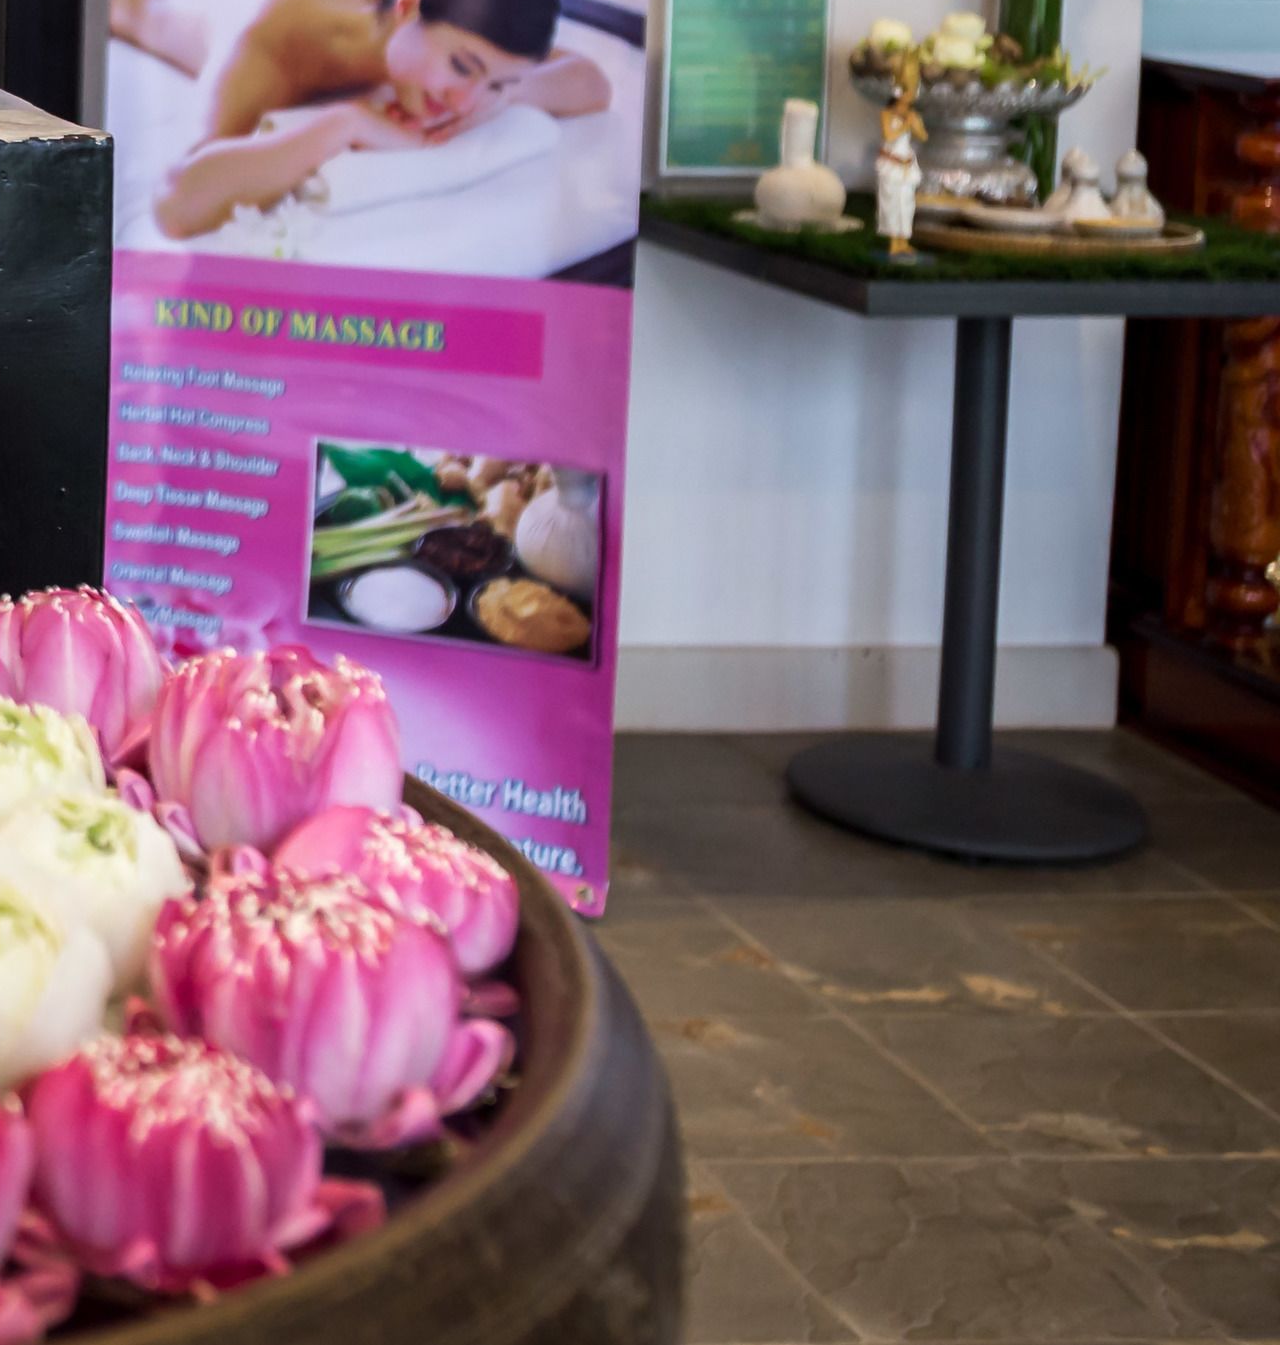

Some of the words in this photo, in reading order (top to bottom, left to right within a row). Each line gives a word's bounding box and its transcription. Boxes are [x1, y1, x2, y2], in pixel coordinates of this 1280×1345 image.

[155, 299, 235, 333] KIND
[241, 304, 283, 338] OF
[289, 311, 446, 353] MASSAGE
[223, 370, 286, 399] Massage
[120, 403, 168, 424] Herbal
[170, 407, 196, 427] Hot
[199, 410, 271, 436] Compress
[198, 448, 212, 468] &
[215, 450, 281, 478] Shoulder
[114, 480, 154, 505] Deep
[204, 489, 270, 520] Massage
[113, 521, 175, 544] Swedish
[176, 527, 241, 556] Massage
[170, 567, 233, 596] Massage
[502, 776, 588, 825] Health
